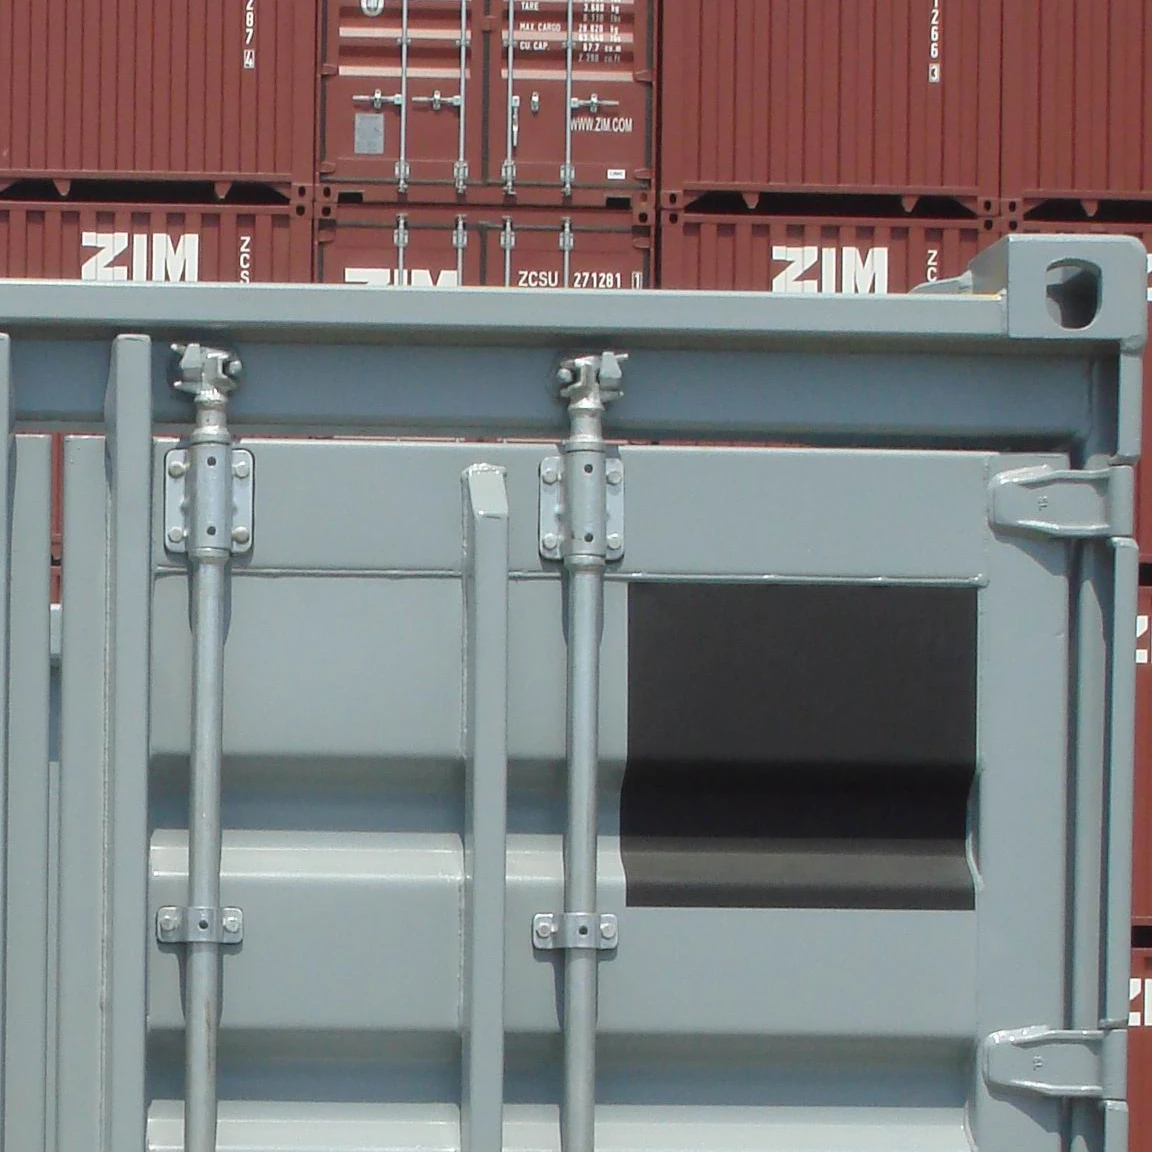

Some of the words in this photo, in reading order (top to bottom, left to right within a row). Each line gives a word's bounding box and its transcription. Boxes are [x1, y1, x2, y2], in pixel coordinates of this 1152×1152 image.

[570, 117, 633, 132] WWW.ZIM.COM
[81, 231, 199, 282] ZIM
[772, 245, 889, 295] ZIM
[518, 270, 559, 287] ZCSU
[573, 271, 622, 289] 271281
